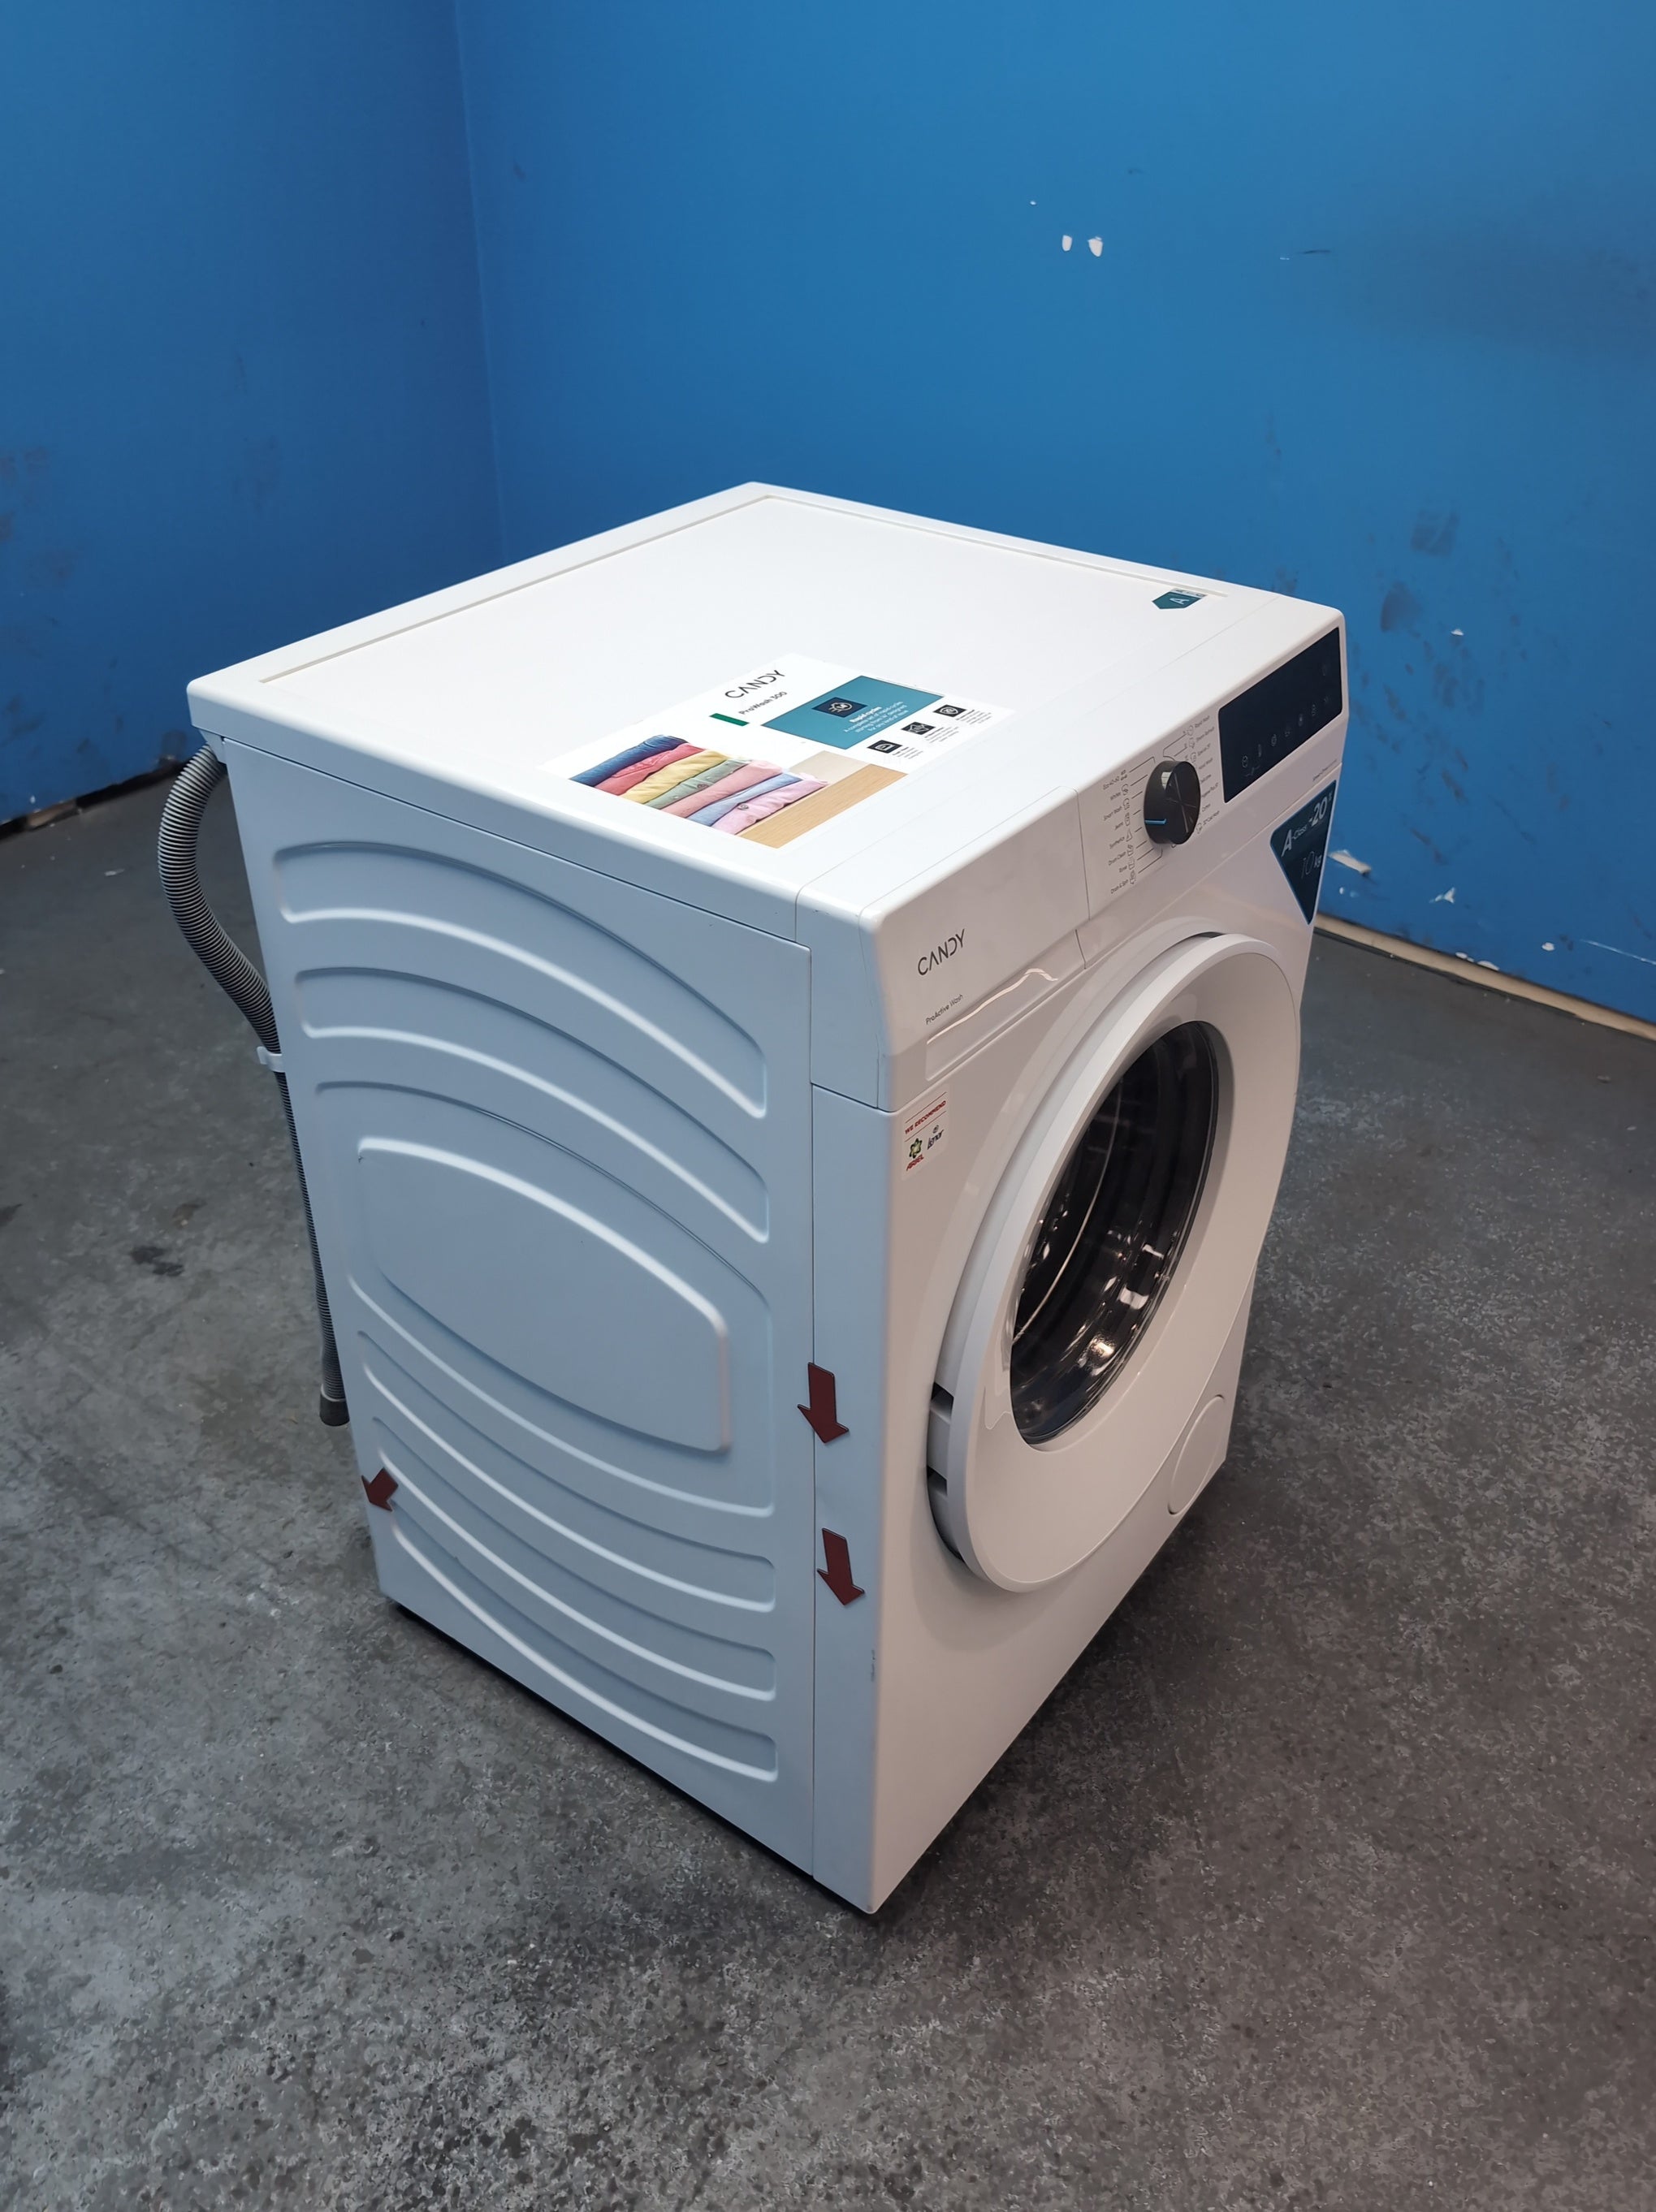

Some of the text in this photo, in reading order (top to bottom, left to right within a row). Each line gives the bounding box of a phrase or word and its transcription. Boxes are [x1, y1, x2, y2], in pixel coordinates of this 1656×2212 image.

[724, 670, 785, 698] CANDY
[738, 698, 773, 715] ProWash
[918, 928, 965, 976] CANDY
[926, 994, 963, 1025] ProActive Wash
[905, 1125, 914, 1134] WE
[914, 1100, 946, 1127] RECOMMEND
